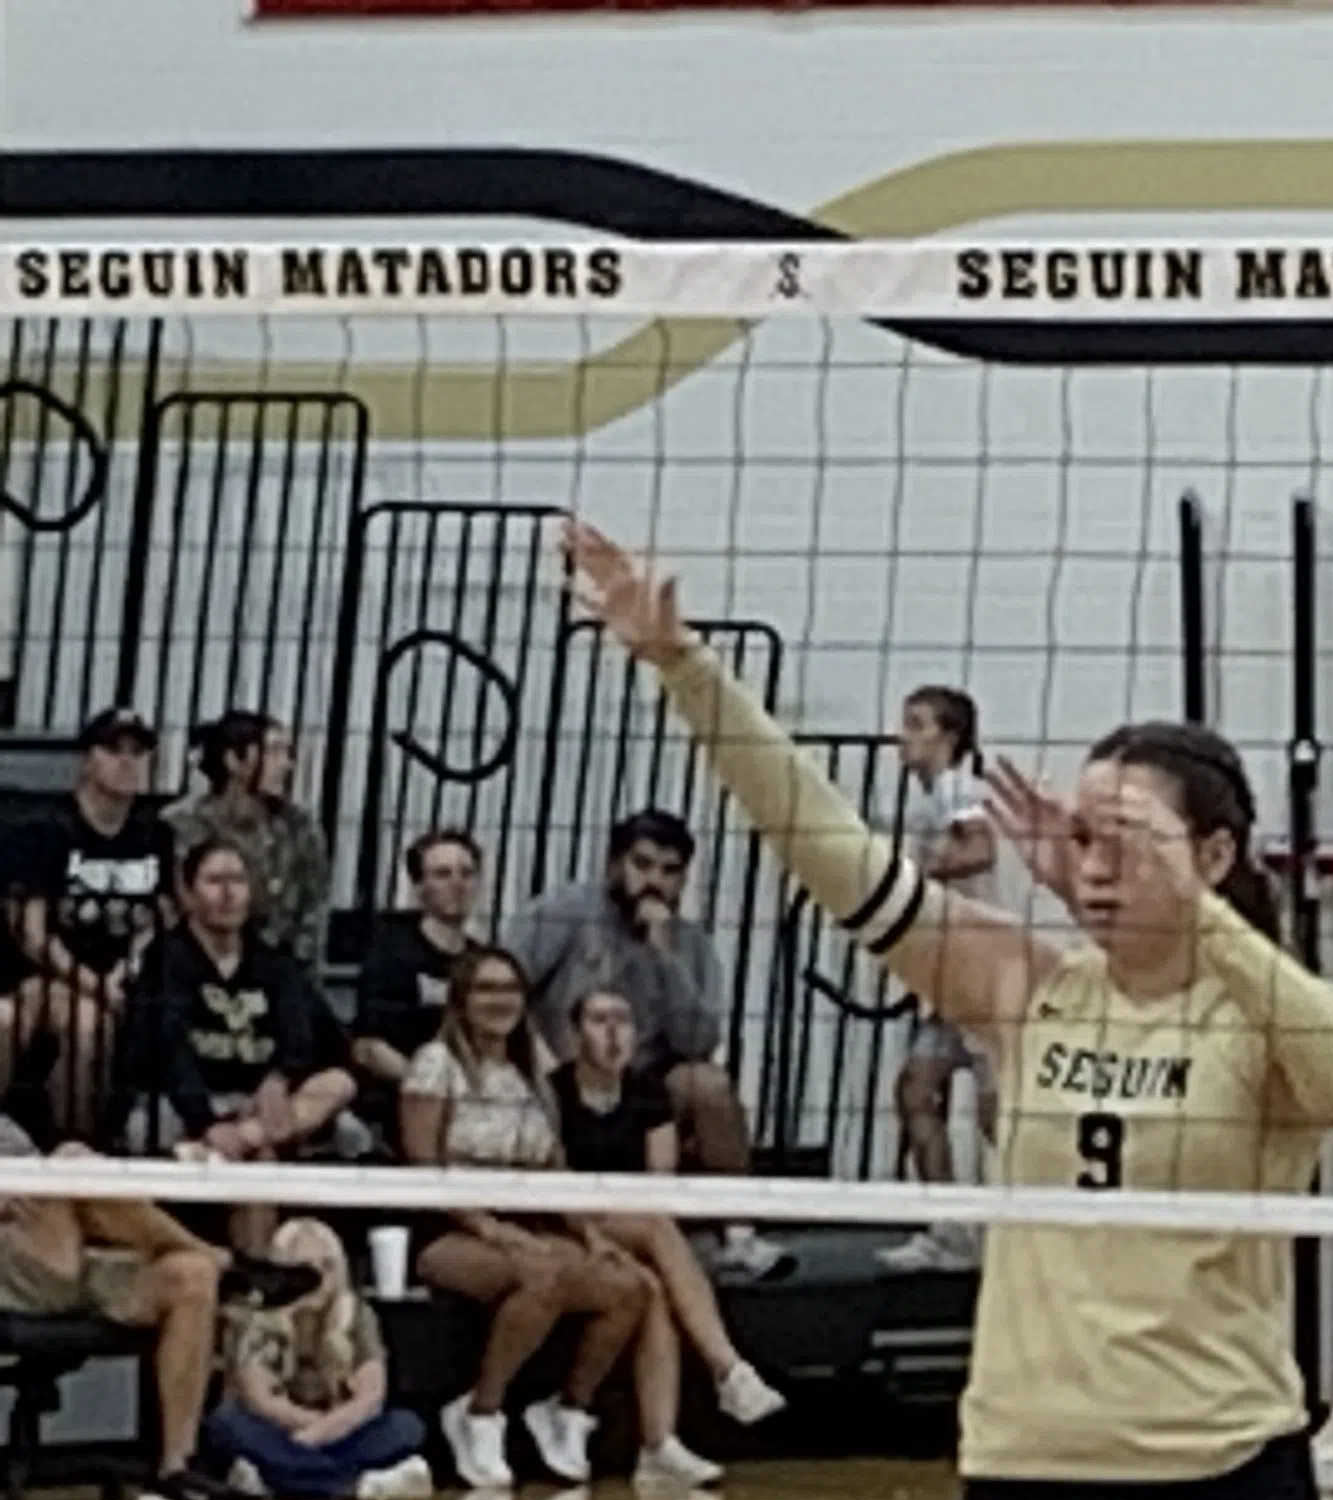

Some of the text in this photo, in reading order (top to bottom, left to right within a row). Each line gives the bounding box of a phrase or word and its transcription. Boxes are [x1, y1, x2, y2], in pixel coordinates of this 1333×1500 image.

[16, 248, 623, 299] SEGUIN MATADORS
[957, 249, 1202, 300] SEGUIN
[1037, 1042, 1192, 1099] SEGUIN
[1077, 1111, 1124, 1189] 9
